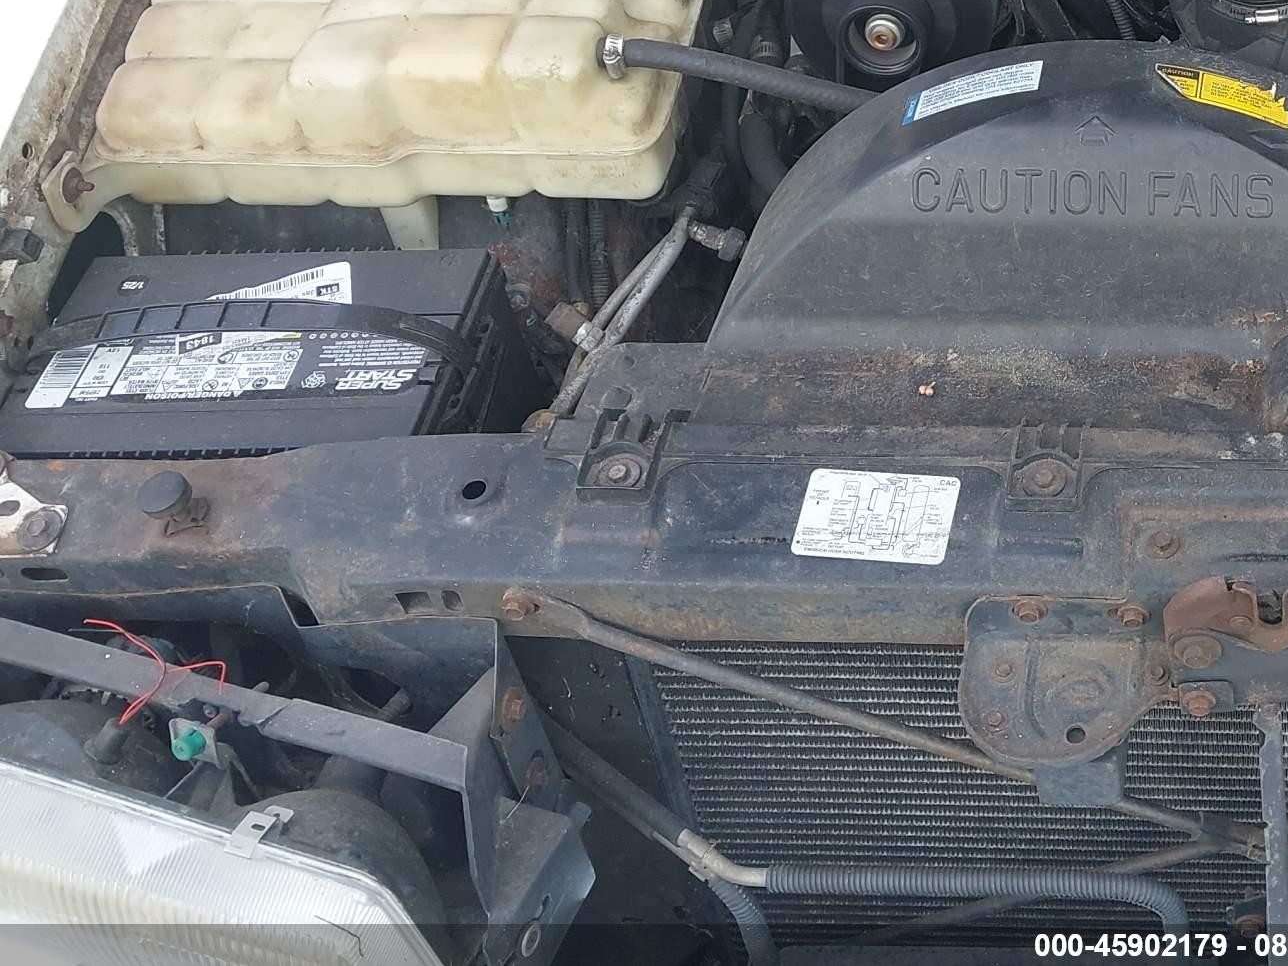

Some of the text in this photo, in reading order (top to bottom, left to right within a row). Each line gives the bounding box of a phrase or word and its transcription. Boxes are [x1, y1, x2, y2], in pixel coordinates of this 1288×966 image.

[911, 167, 1274, 219] CAUTION FANS
[121, 280, 145, 291] 1/25
[320, 285, 338, 296] STK
[185, 334, 215, 350] 1843
[343, 369, 417, 381] START
[334, 380, 402, 390] SUPER
[144, 391, 232, 400] DANGER/POISON
[939, 479, 958, 487] CAC
